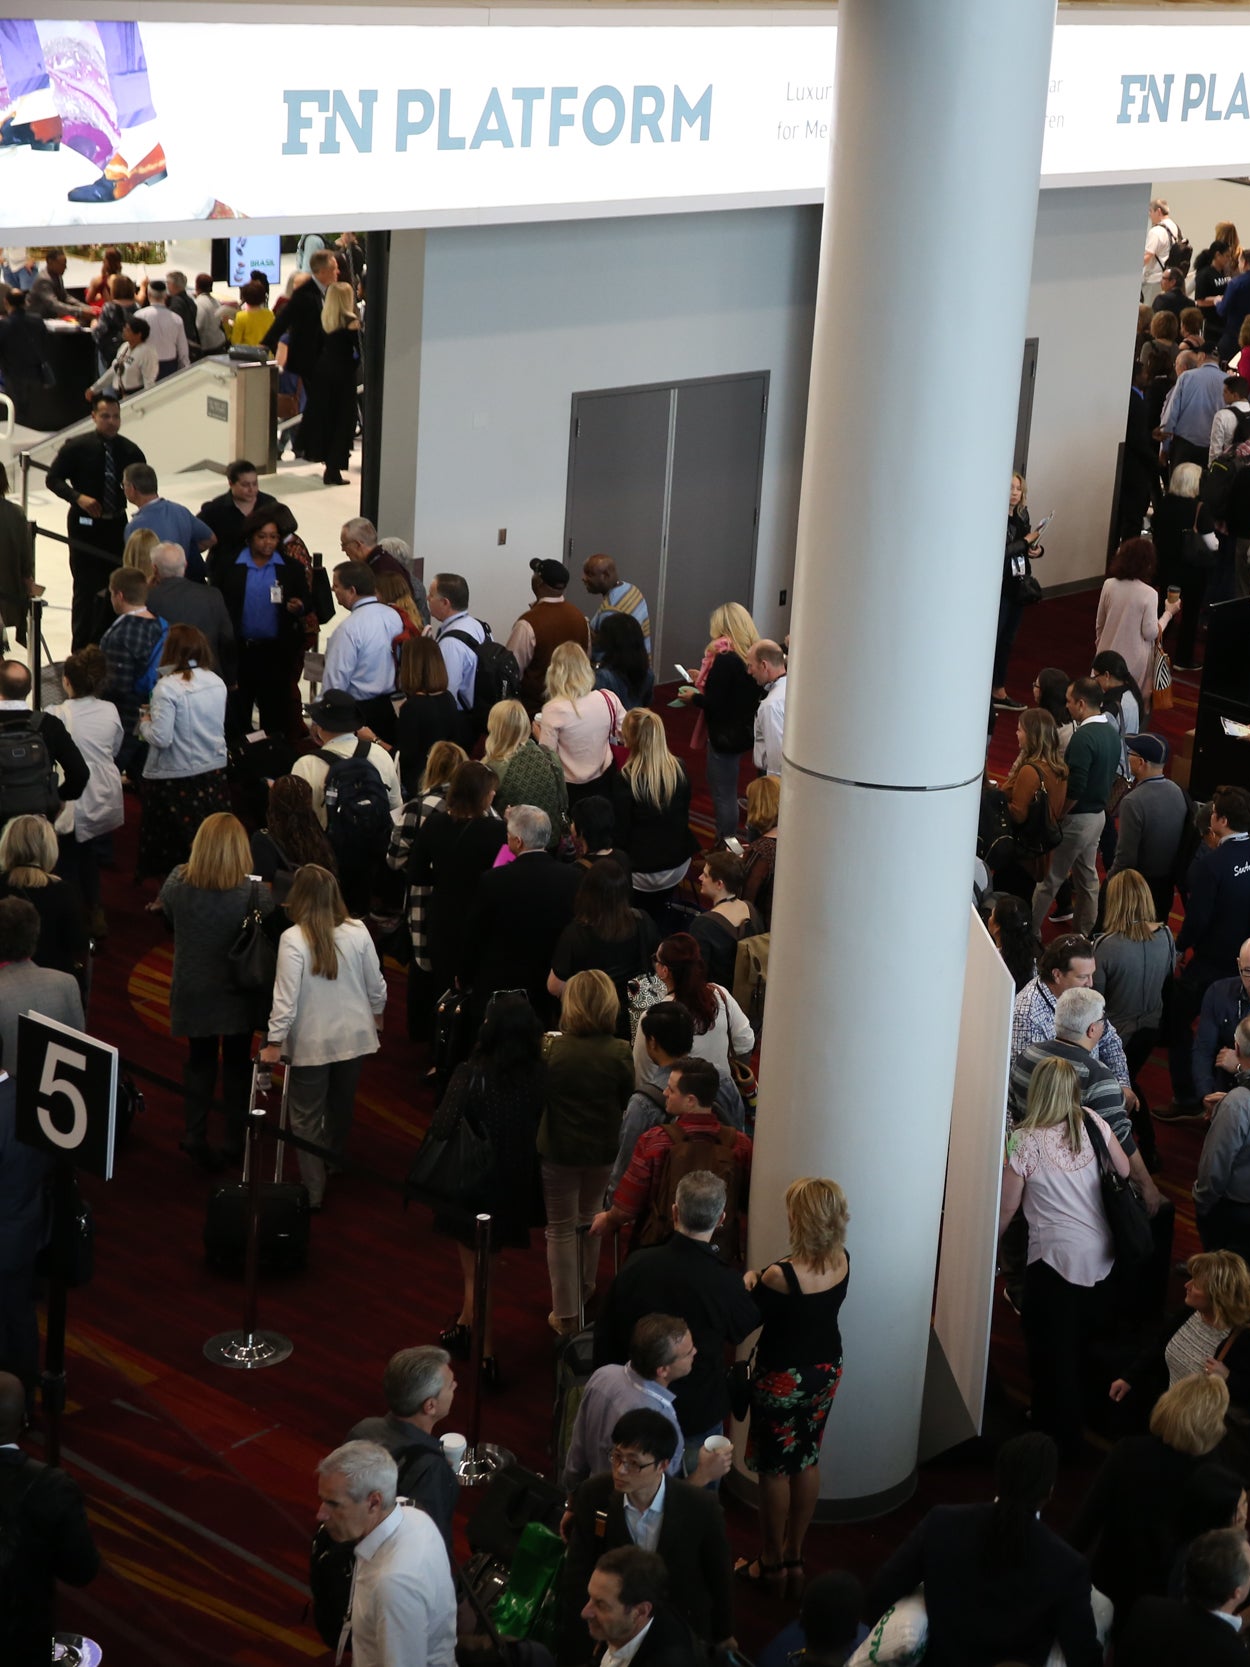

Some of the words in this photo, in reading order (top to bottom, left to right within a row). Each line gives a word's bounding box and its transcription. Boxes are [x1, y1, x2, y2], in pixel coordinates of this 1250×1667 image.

[786, 81, 832, 102] Luxur
[1116, 73, 1175, 124] FN
[281, 89, 379, 156] FN
[395, 83, 714, 154] PLATFORM
[777, 120, 800, 140] for
[805, 119, 828, 139] Me
[37, 1041, 89, 1150] 5
